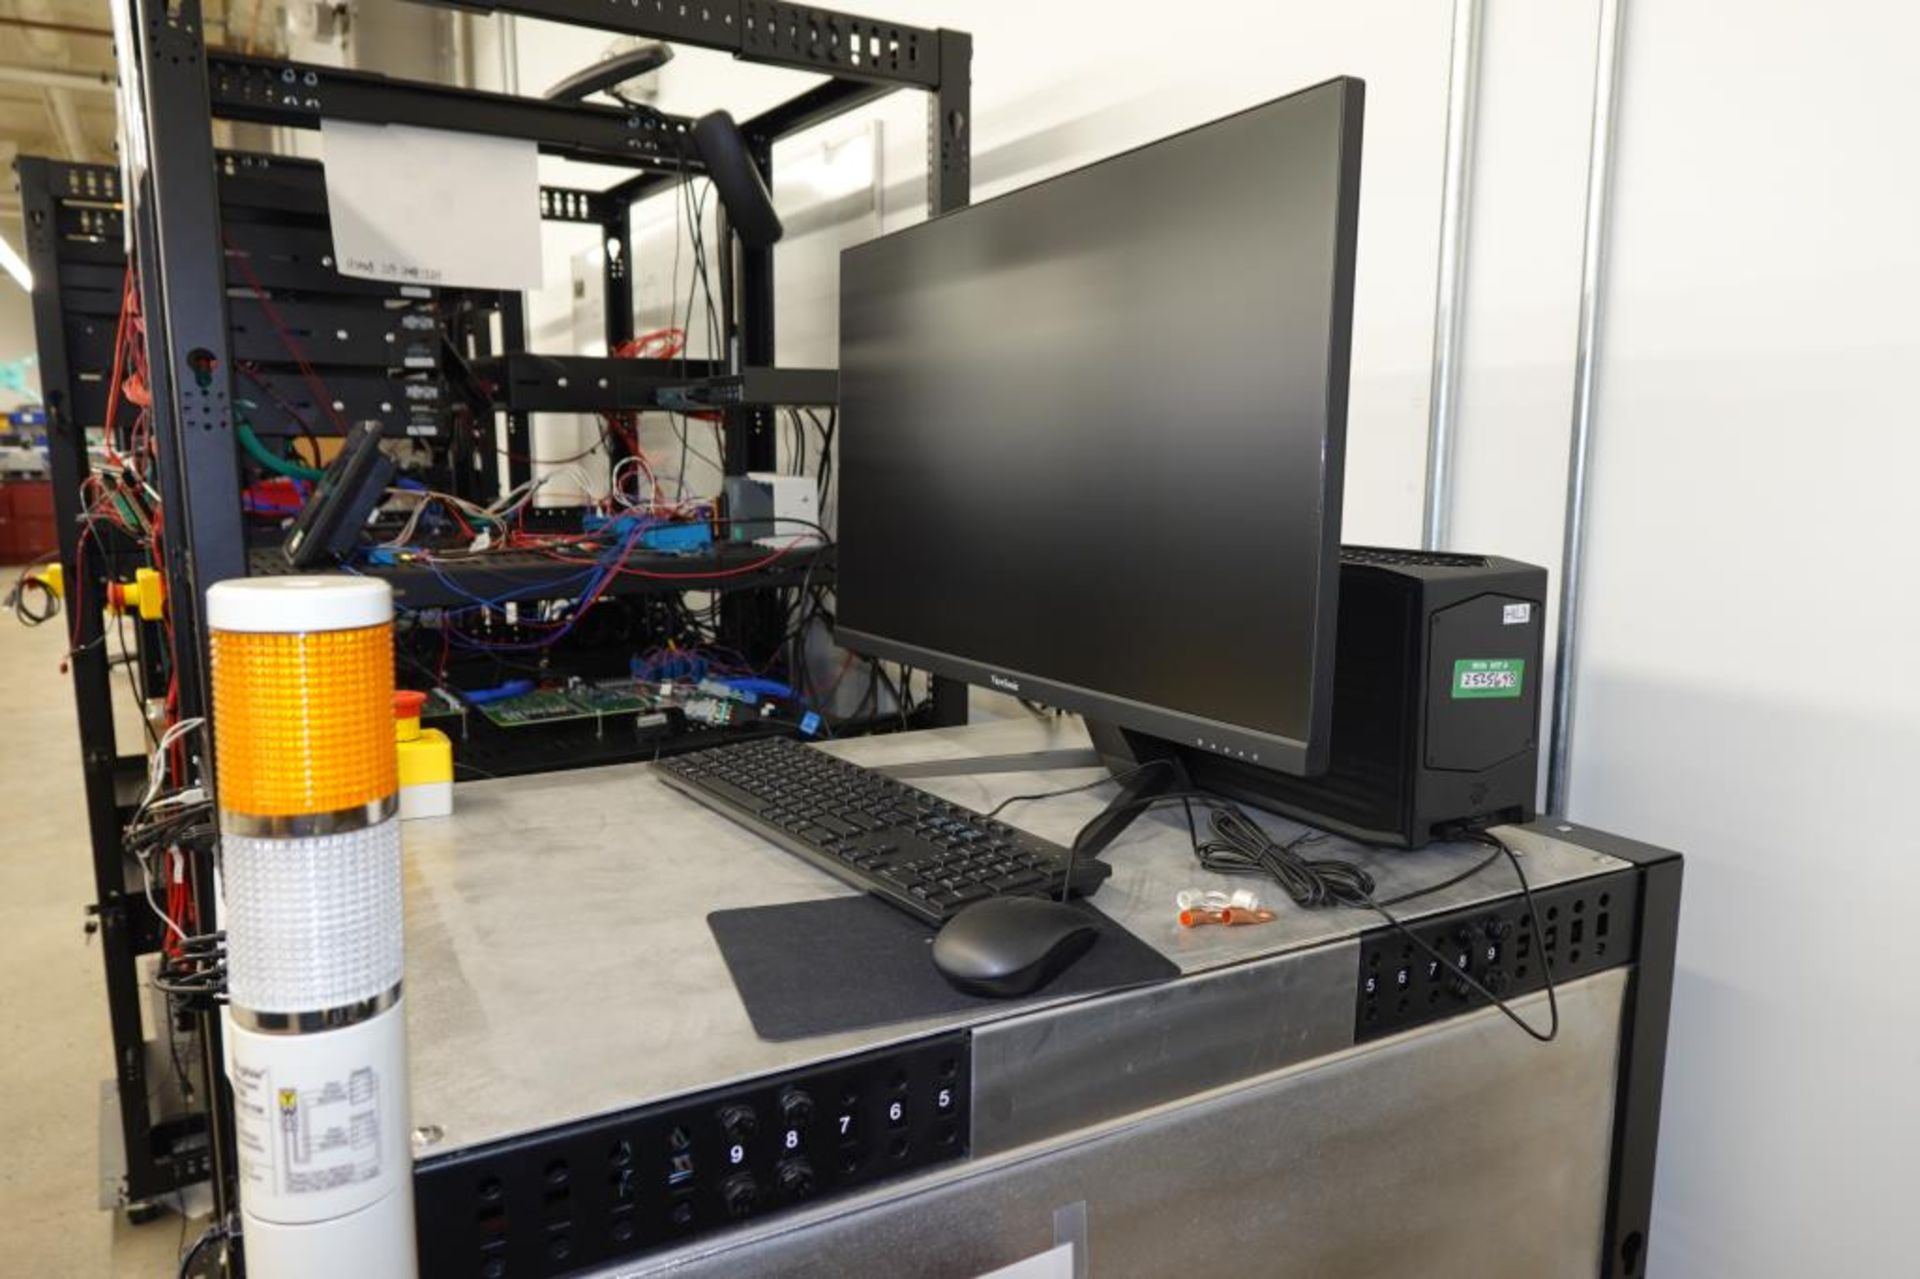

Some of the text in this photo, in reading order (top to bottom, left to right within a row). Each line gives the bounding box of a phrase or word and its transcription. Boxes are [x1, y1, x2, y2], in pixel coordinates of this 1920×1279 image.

[1366, 946, 1496, 992] 5 6 7 8 9
[730, 1089, 950, 1163] 9 8 7 6 5
